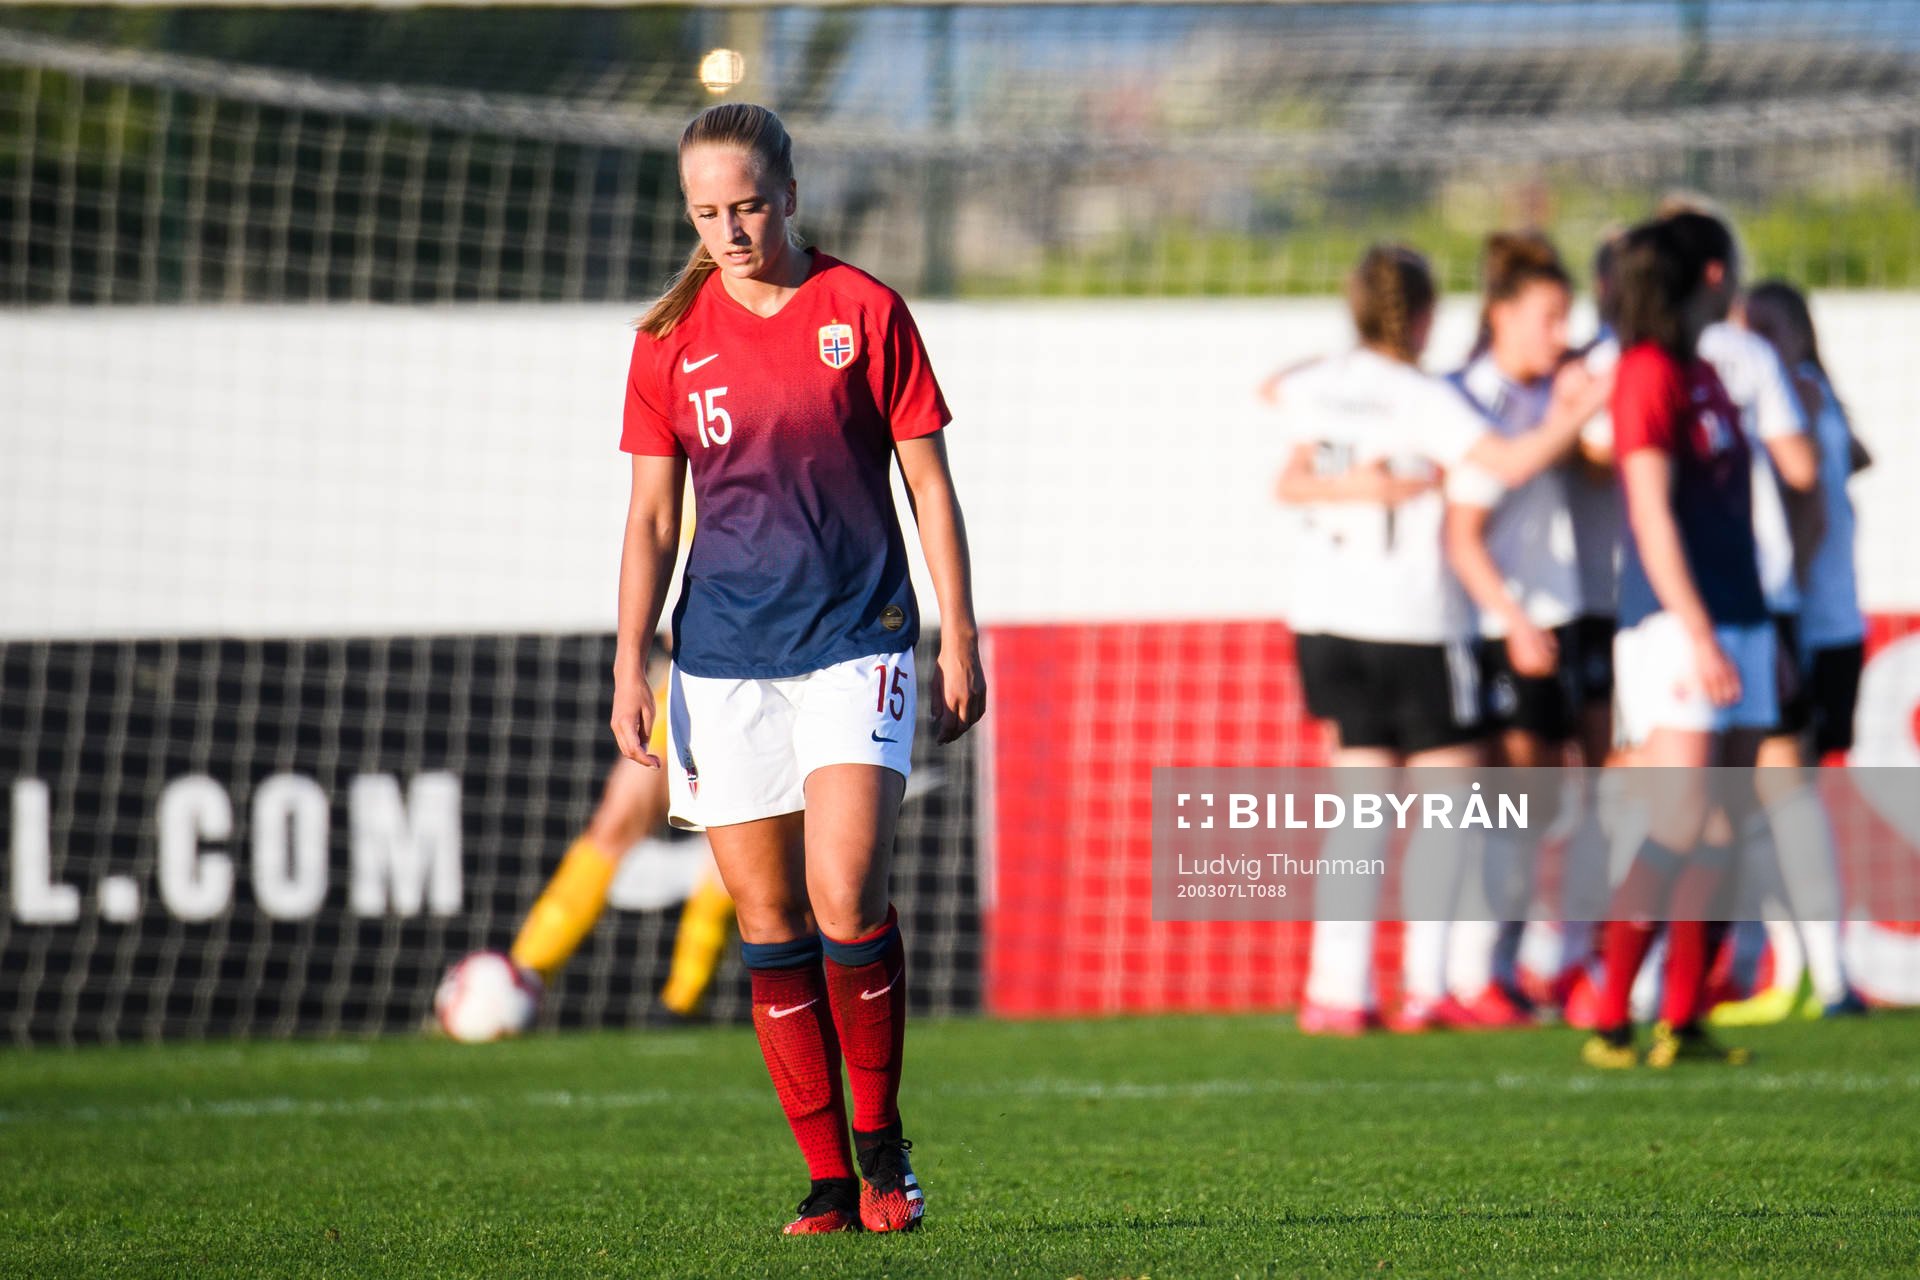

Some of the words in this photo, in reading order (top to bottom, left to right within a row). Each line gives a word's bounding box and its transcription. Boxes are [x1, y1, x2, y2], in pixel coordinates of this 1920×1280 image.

[688, 386, 733, 448] 15
[874, 664, 908, 722] 15
[12, 771, 463, 923] L.COM
